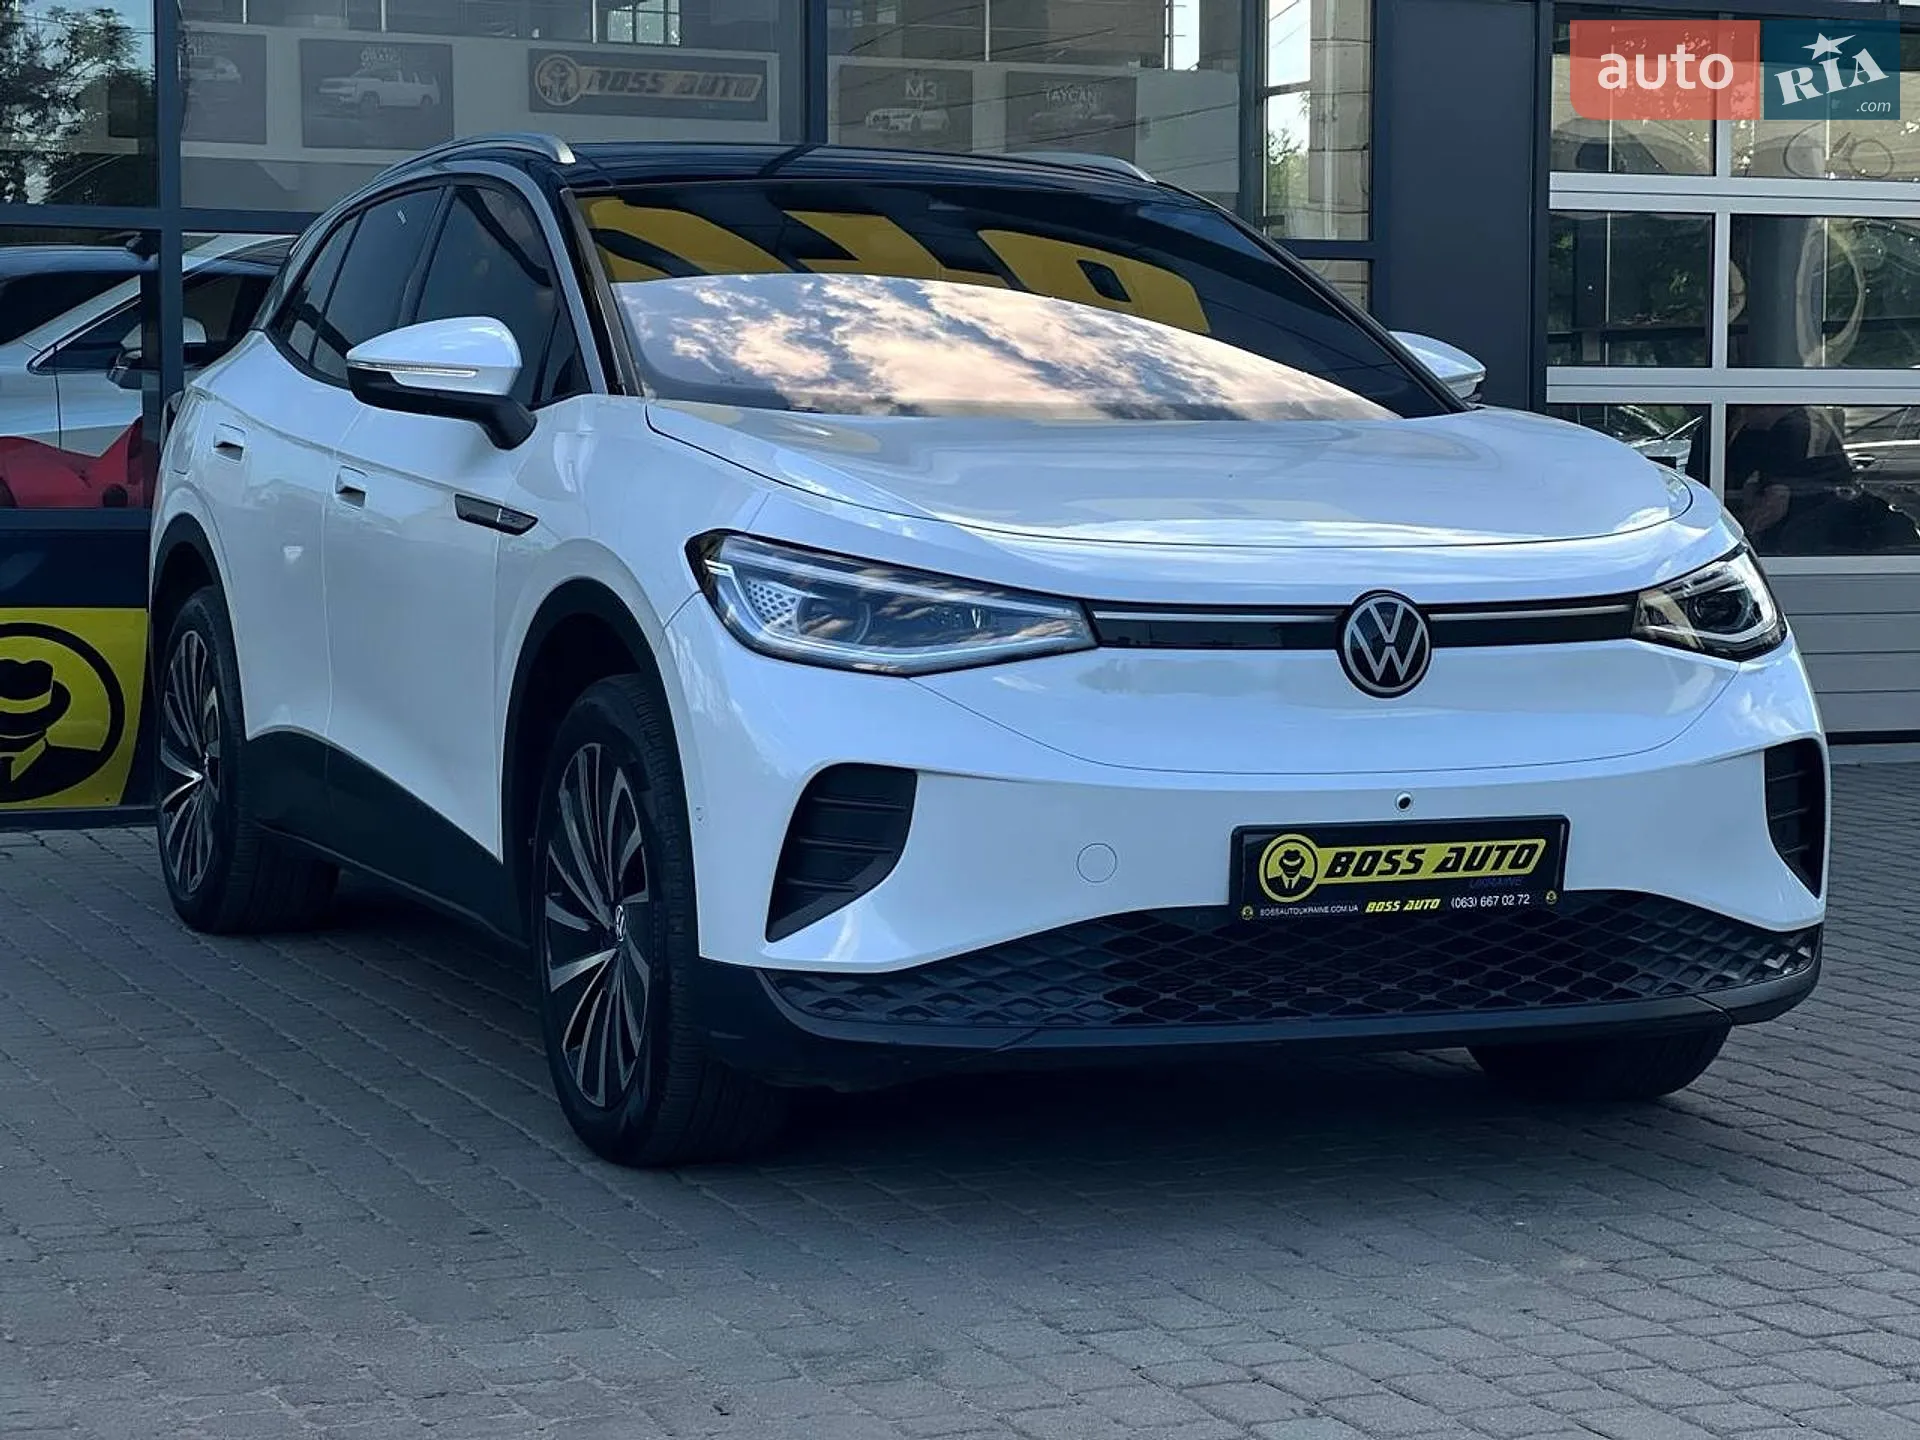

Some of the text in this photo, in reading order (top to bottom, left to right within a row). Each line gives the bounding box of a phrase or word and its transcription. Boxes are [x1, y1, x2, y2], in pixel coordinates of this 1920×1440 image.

[904, 77, 937, 101] M3
[1323, 842, 1541, 879] BOSS AUTO
[1364, 900, 1401, 913] BOSS
[1403, 898, 1441, 911] AUTO
[1450, 897, 1478, 909] (063)
[1480, 895, 1500, 908] 667
[1501, 894, 1516, 906] 02
[1517, 893, 1531, 905] 72
